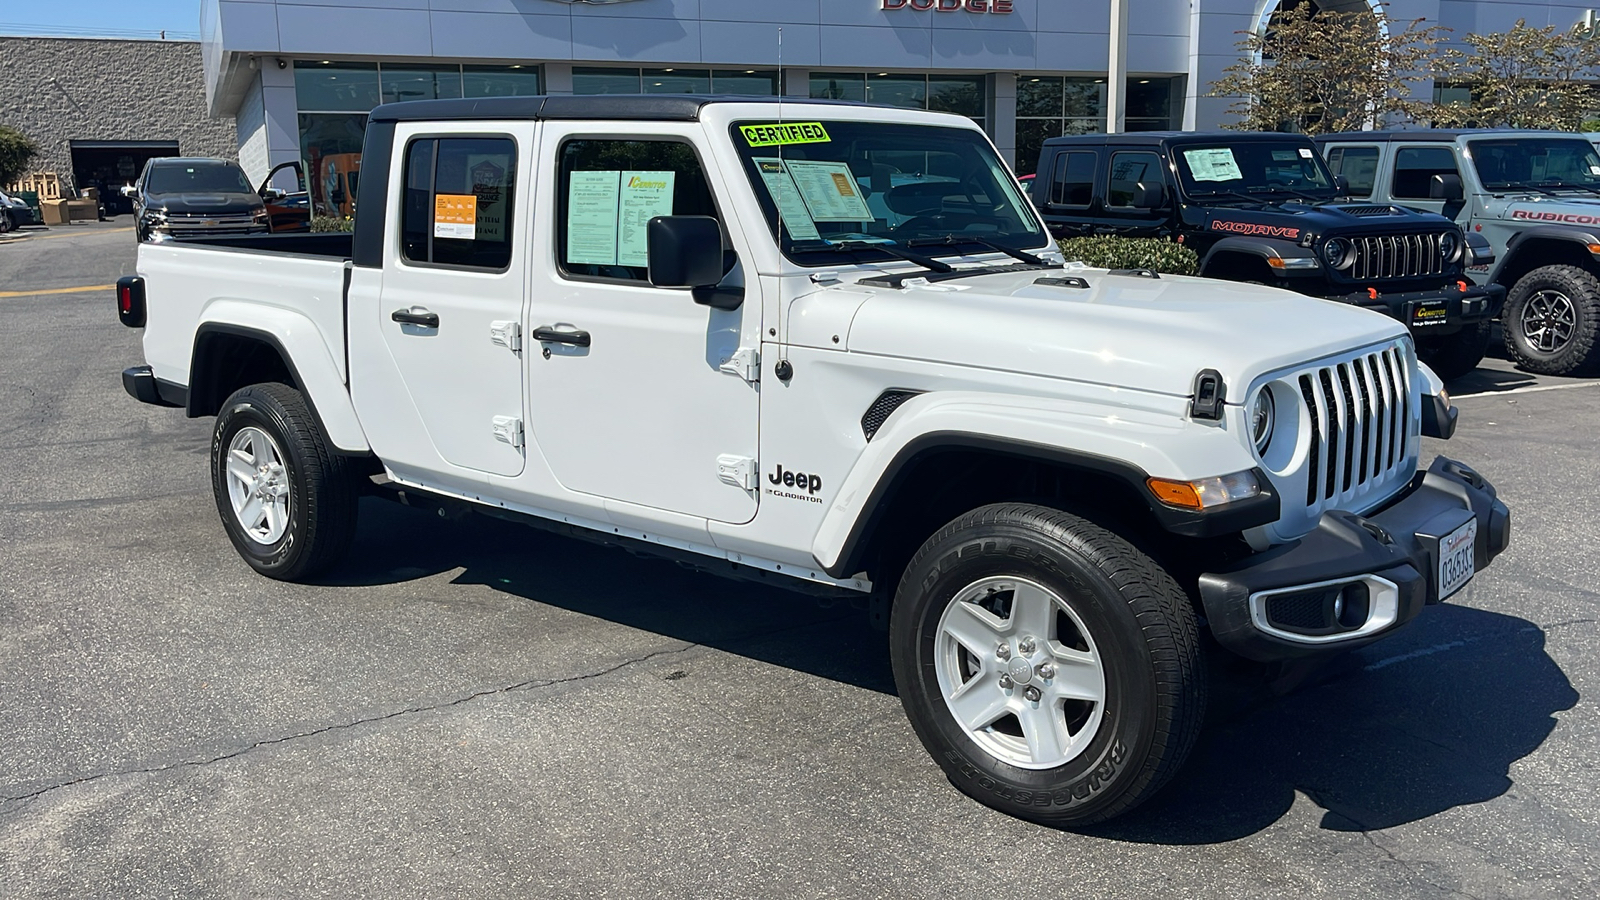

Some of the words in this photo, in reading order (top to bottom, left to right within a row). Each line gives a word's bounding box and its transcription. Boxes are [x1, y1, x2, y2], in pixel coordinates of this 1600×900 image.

[881, 0, 1014, 14] DODGE
[744, 124, 827, 144] CERTIFIED
[1211, 220, 1300, 239] MOJAVE
[768, 463, 823, 495] Jeep
[773, 489, 824, 504] GLADIATOR
[945, 738, 1127, 808] BRIDGESTONE
